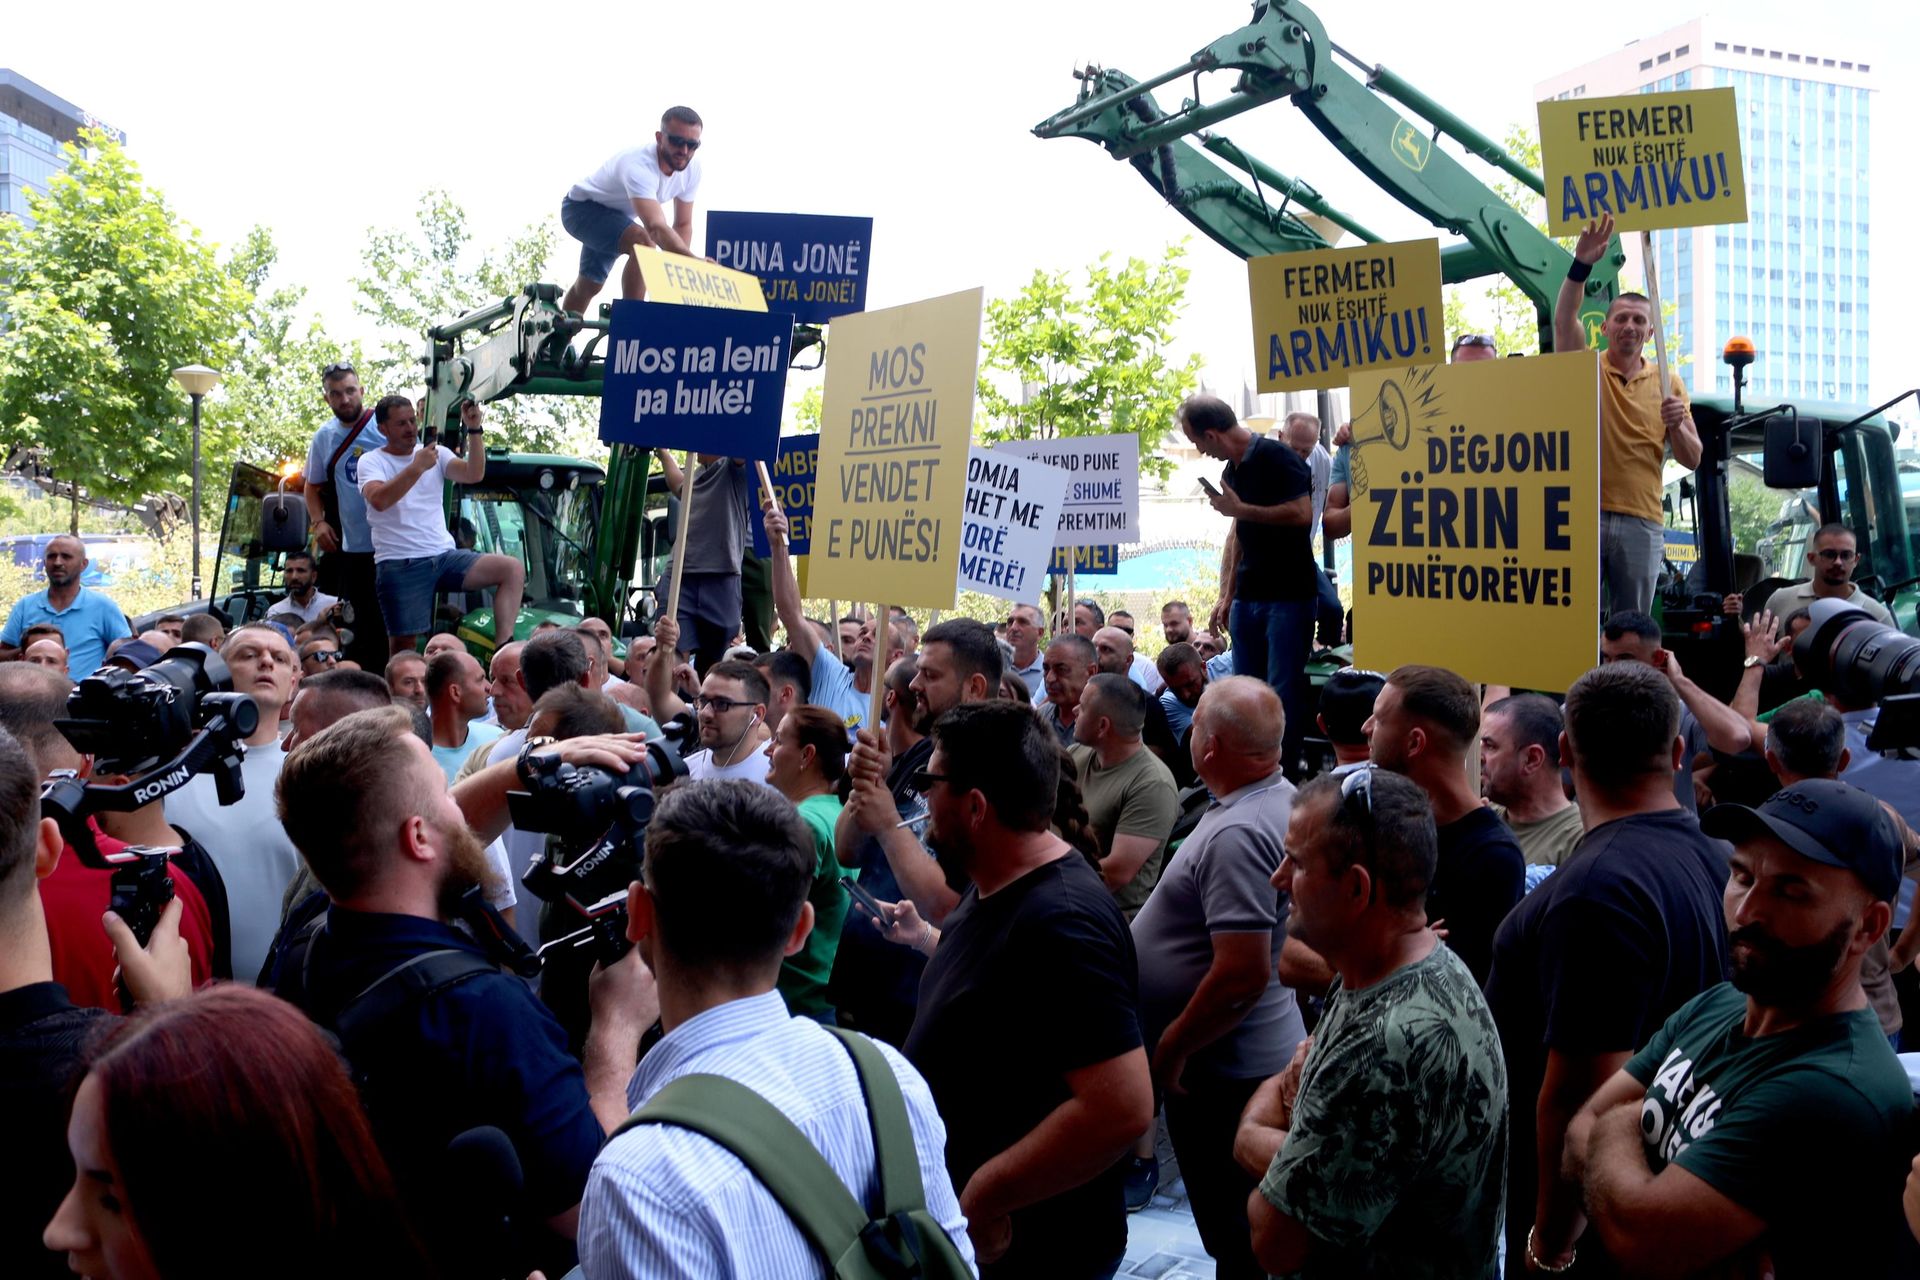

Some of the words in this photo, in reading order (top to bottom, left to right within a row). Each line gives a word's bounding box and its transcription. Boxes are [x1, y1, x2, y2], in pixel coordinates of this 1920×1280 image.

[1578, 104, 1693, 141] FERMERI
[1593, 145, 1628, 167] NUK
[1634, 138, 1687, 165] ËSHTË
[1562, 152, 1731, 222] ARMIKU!
[716, 240, 784, 273] PUNA
[792, 241, 861, 275] JONË
[663, 261, 742, 304] FERMERI
[760, 278, 798, 301] EJTA
[803, 278, 855, 303] JONË!
[1284, 257, 1395, 298] FERMERI
[1298, 302, 1331, 324] NUK
[1337, 293, 1388, 321] ËSHTË
[614, 339, 676, 374] Mos
[682, 346, 716, 373] na
[722, 335, 781, 373] leni
[1268, 307, 1431, 381] ARMIKU!
[869, 342, 926, 391] MOS
[633, 388, 667, 423] pa
[674, 379, 755, 415] bukë!
[850, 400, 937, 448] PREKNI
[773, 449, 818, 477] MBR
[1084, 453, 1120, 470] PUNE
[1427, 424, 1570, 475] DËGJONI
[840, 459, 940, 503] VENDET
[968, 457, 1019, 493] OMIA
[1073, 479, 1122, 500] SHUMË
[757, 482, 815, 511] PROD
[964, 487, 1007, 520] HET
[1009, 500, 1044, 530] ME
[1368, 471, 1518, 549] ZËRIN
[1544, 486, 1571, 551] E
[828, 519, 843, 558] E
[850, 509, 941, 563] PUNËS!
[964, 522, 1008, 556] ORË
[1057, 512, 1127, 531] PREMTIM!
[1055, 545, 1114, 570] HME!
[1665, 545, 1690, 558] DHIMI
[959, 552, 1026, 591] MERË!
[1368, 554, 1572, 607] PUNËTORËVE!
[133, 764, 190, 804] RONIN
[574, 840, 615, 878] RONIN
